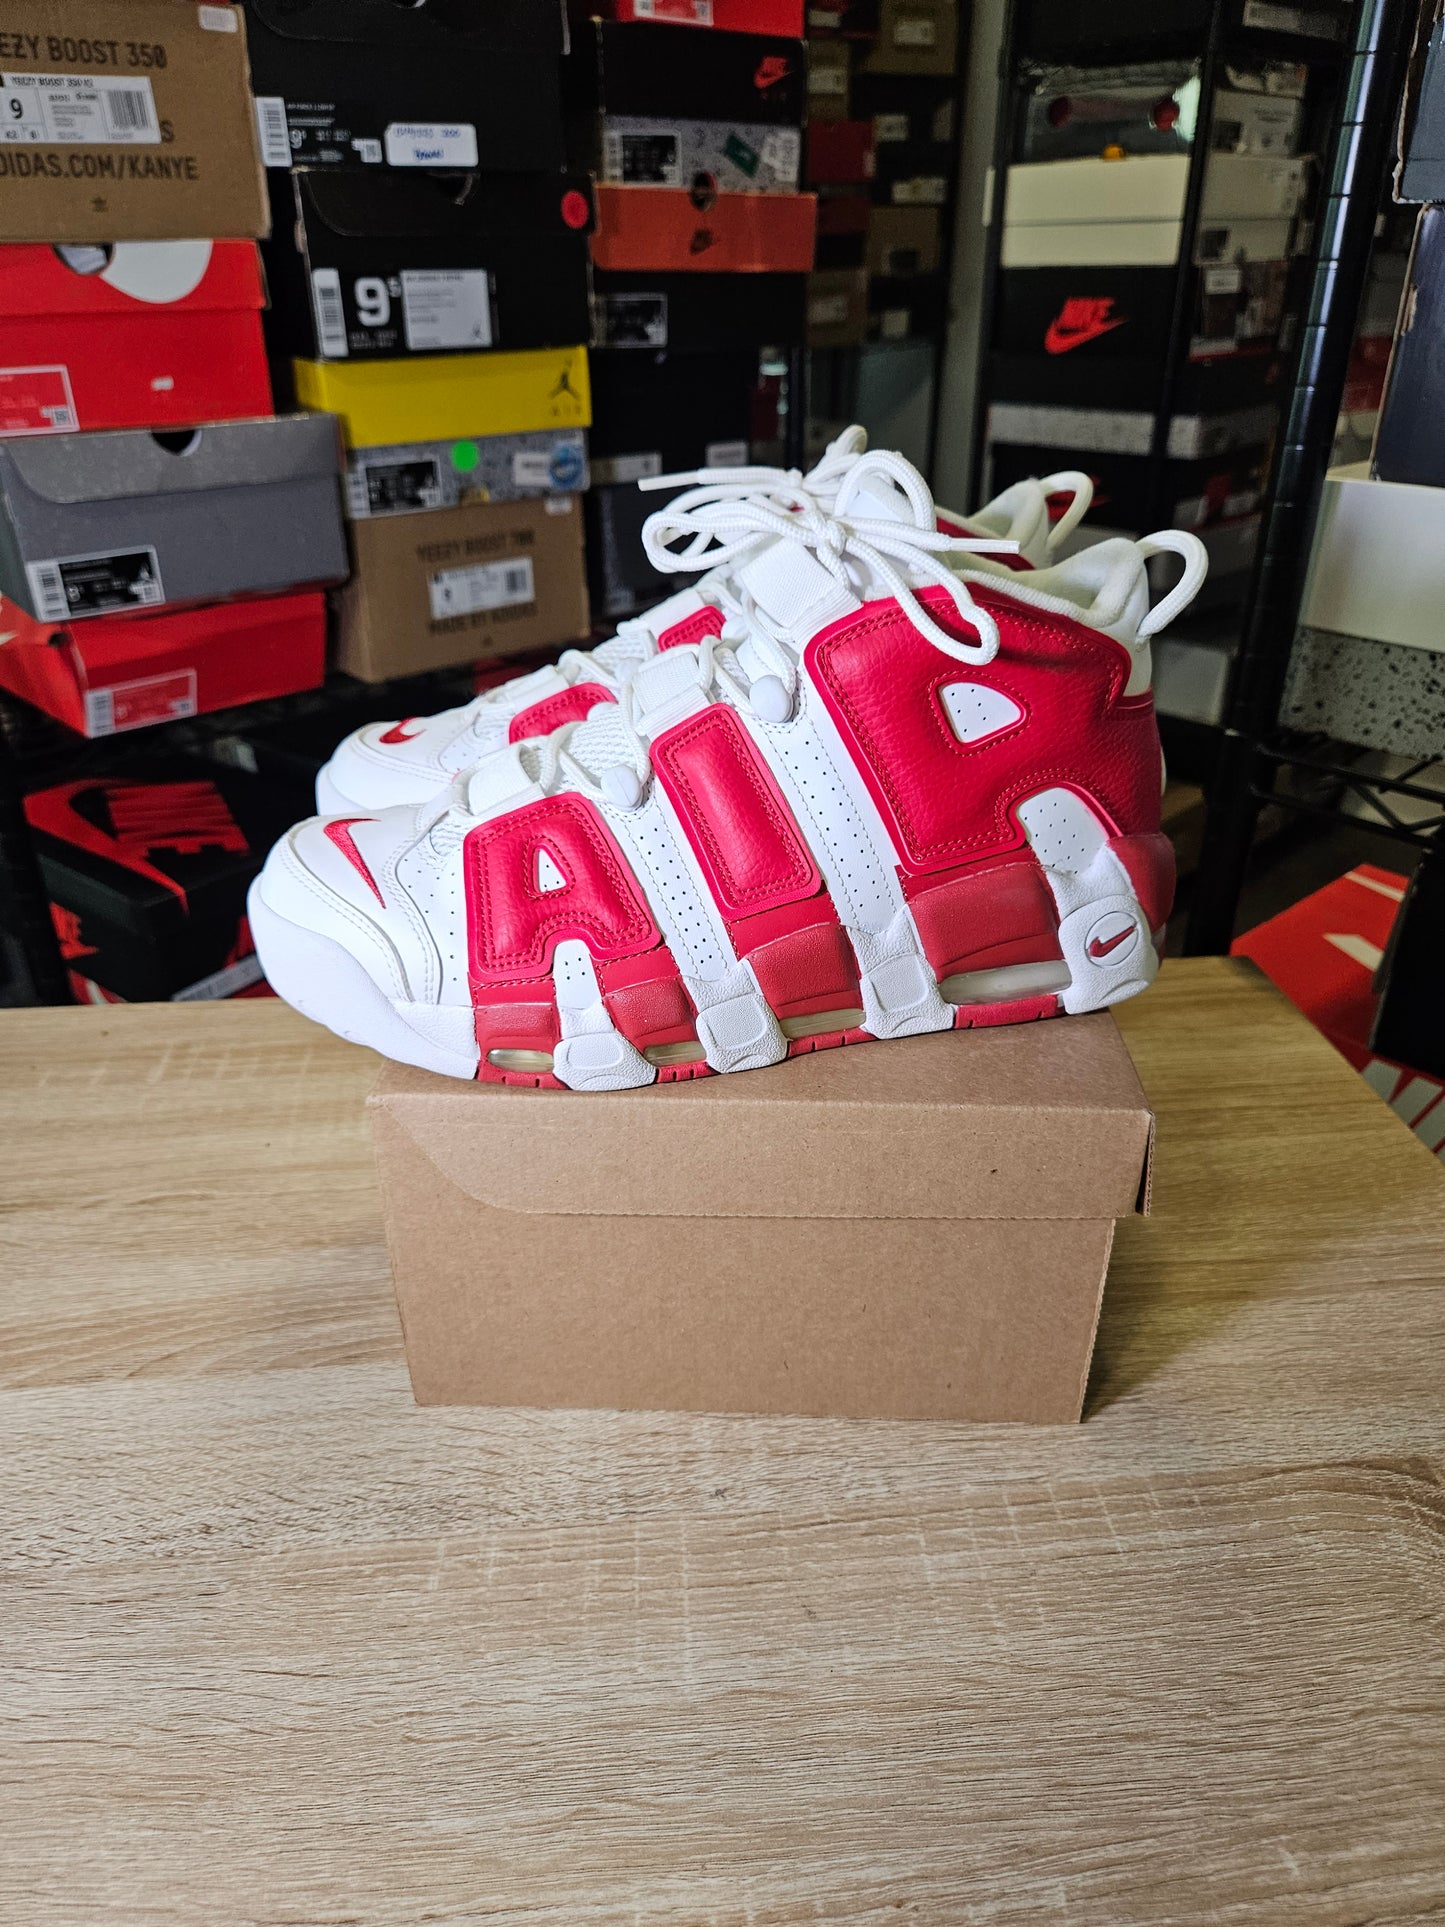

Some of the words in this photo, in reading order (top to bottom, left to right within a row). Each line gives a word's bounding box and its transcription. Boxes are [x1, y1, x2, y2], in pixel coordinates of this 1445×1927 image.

[48, 37, 121, 66] BOOST
[126, 43, 168, 69] 350
[10, 97, 24, 120] 9
